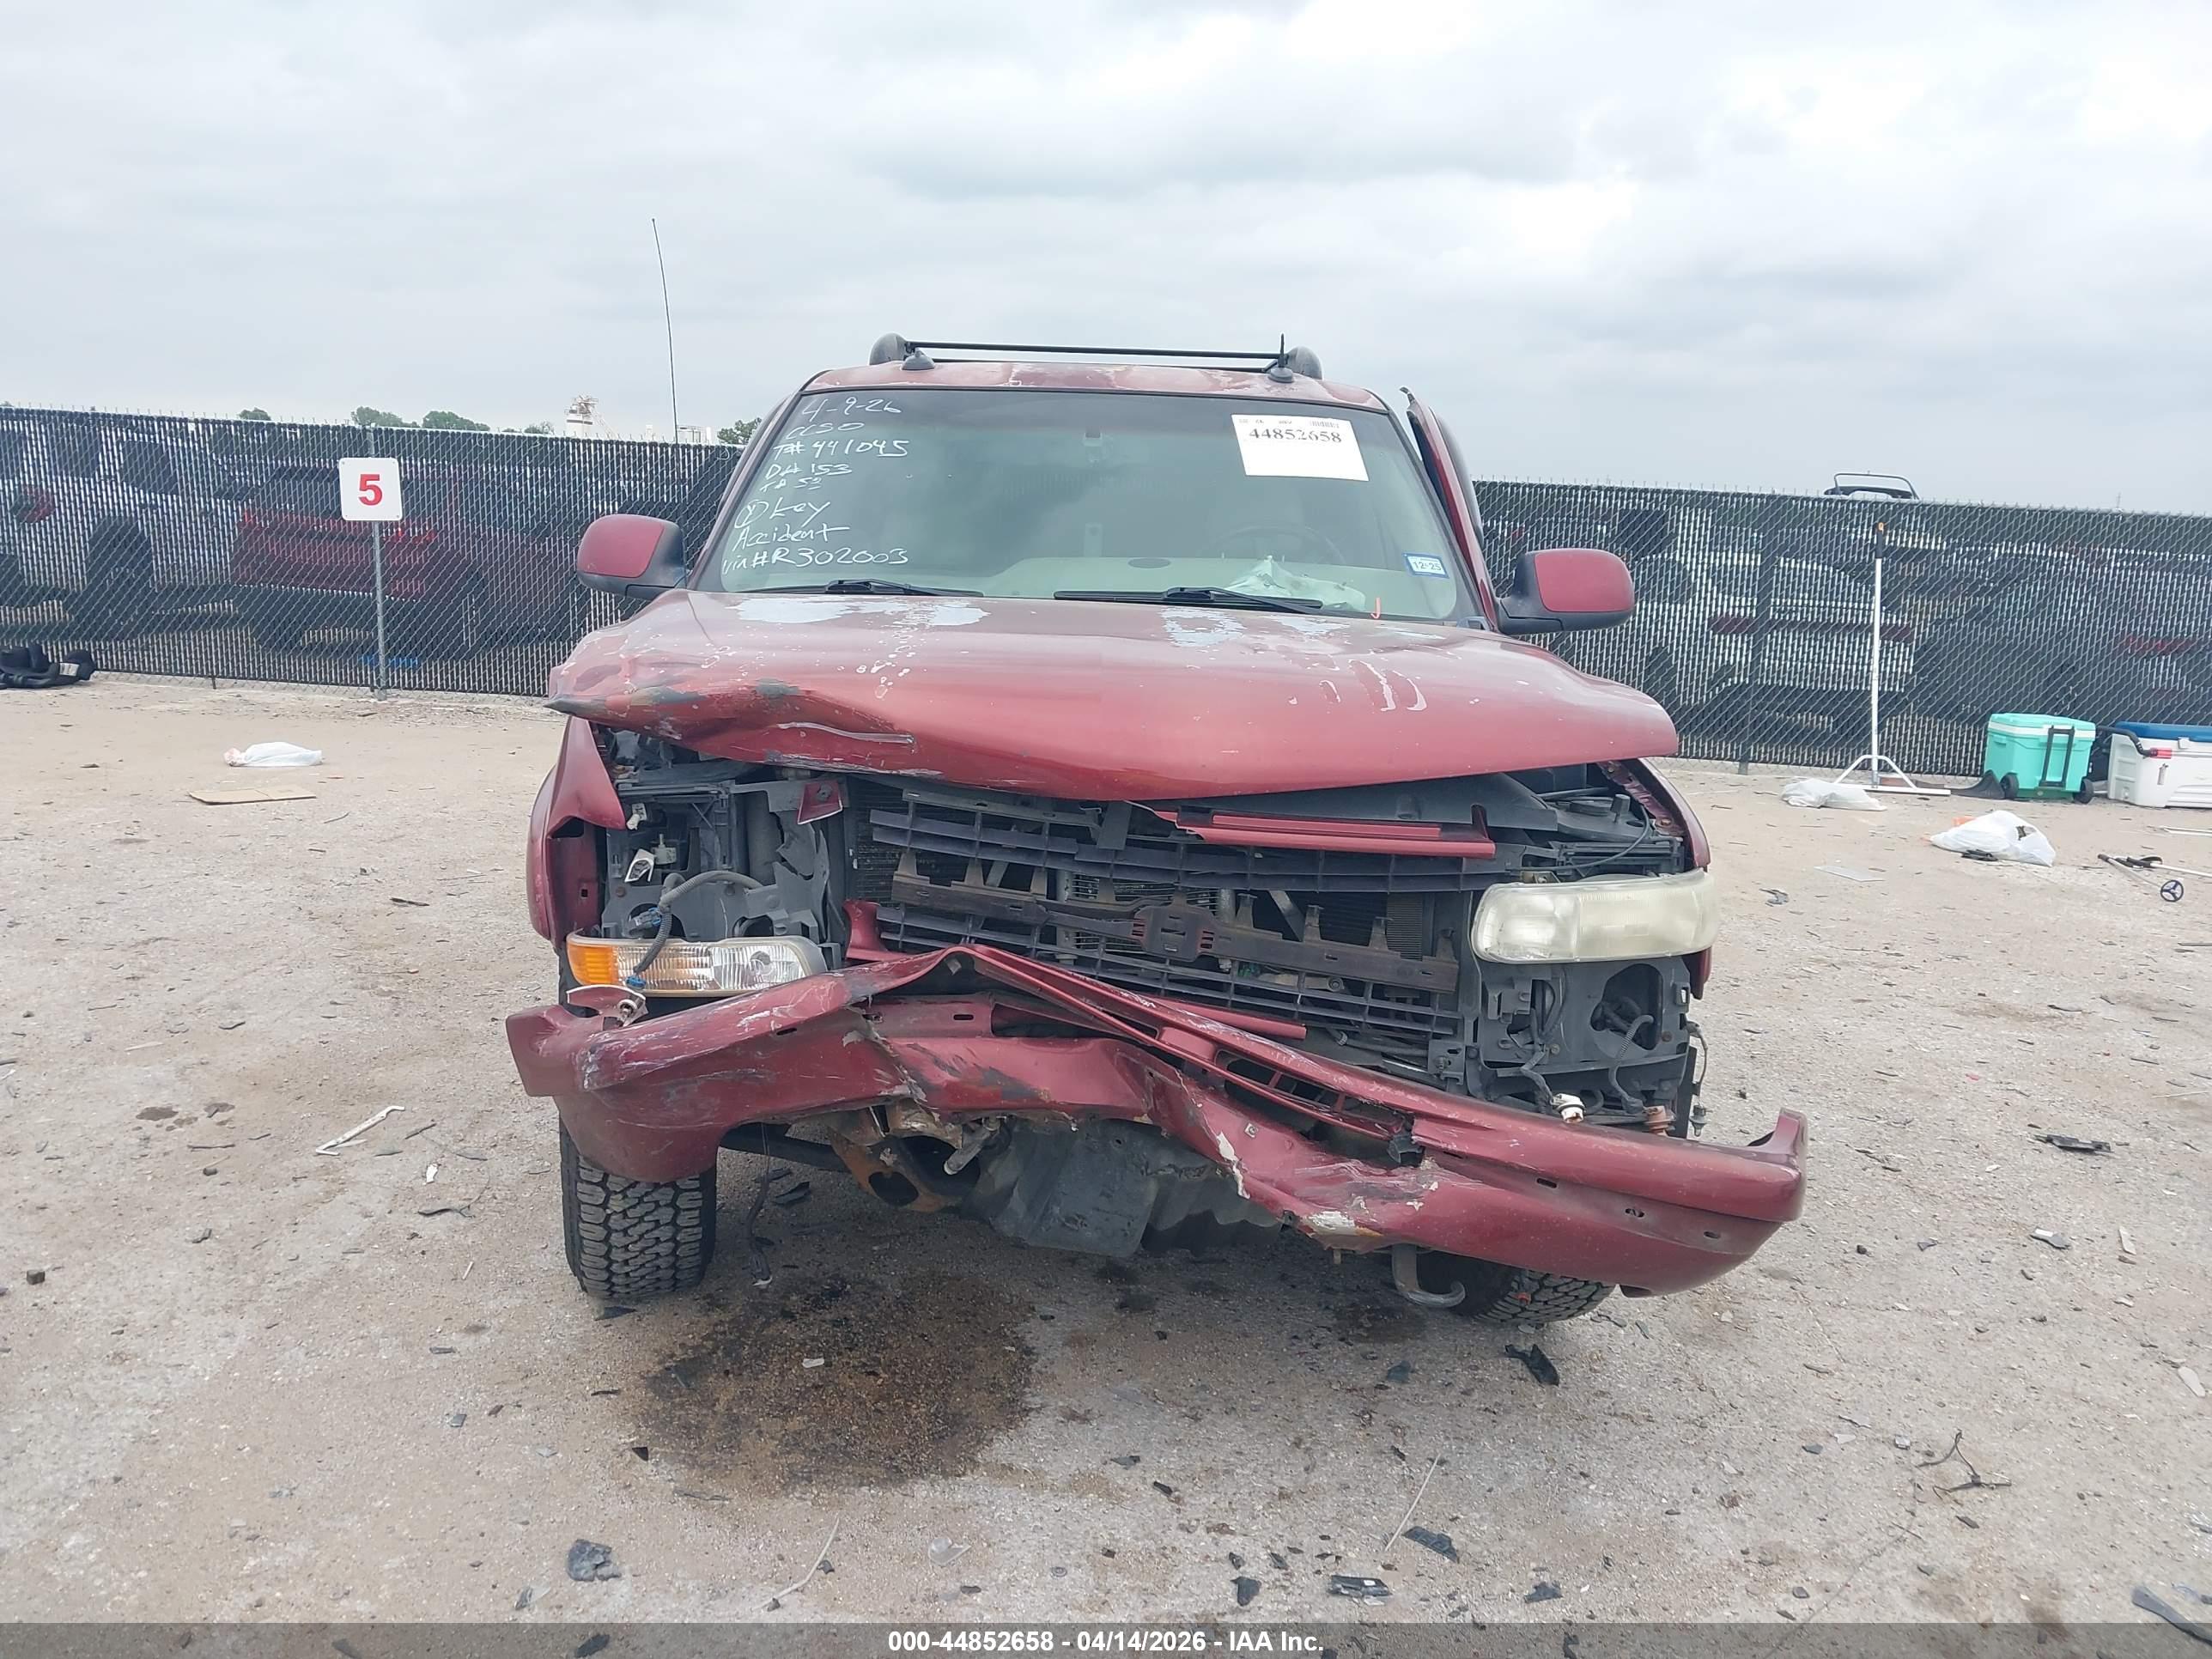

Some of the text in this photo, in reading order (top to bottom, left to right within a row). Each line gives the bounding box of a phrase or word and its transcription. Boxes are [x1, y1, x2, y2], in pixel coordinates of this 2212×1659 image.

[802, 397, 902, 422] 4-9-26
[1249, 428, 1342, 443] 44852658
[358, 473, 383, 506] 5
